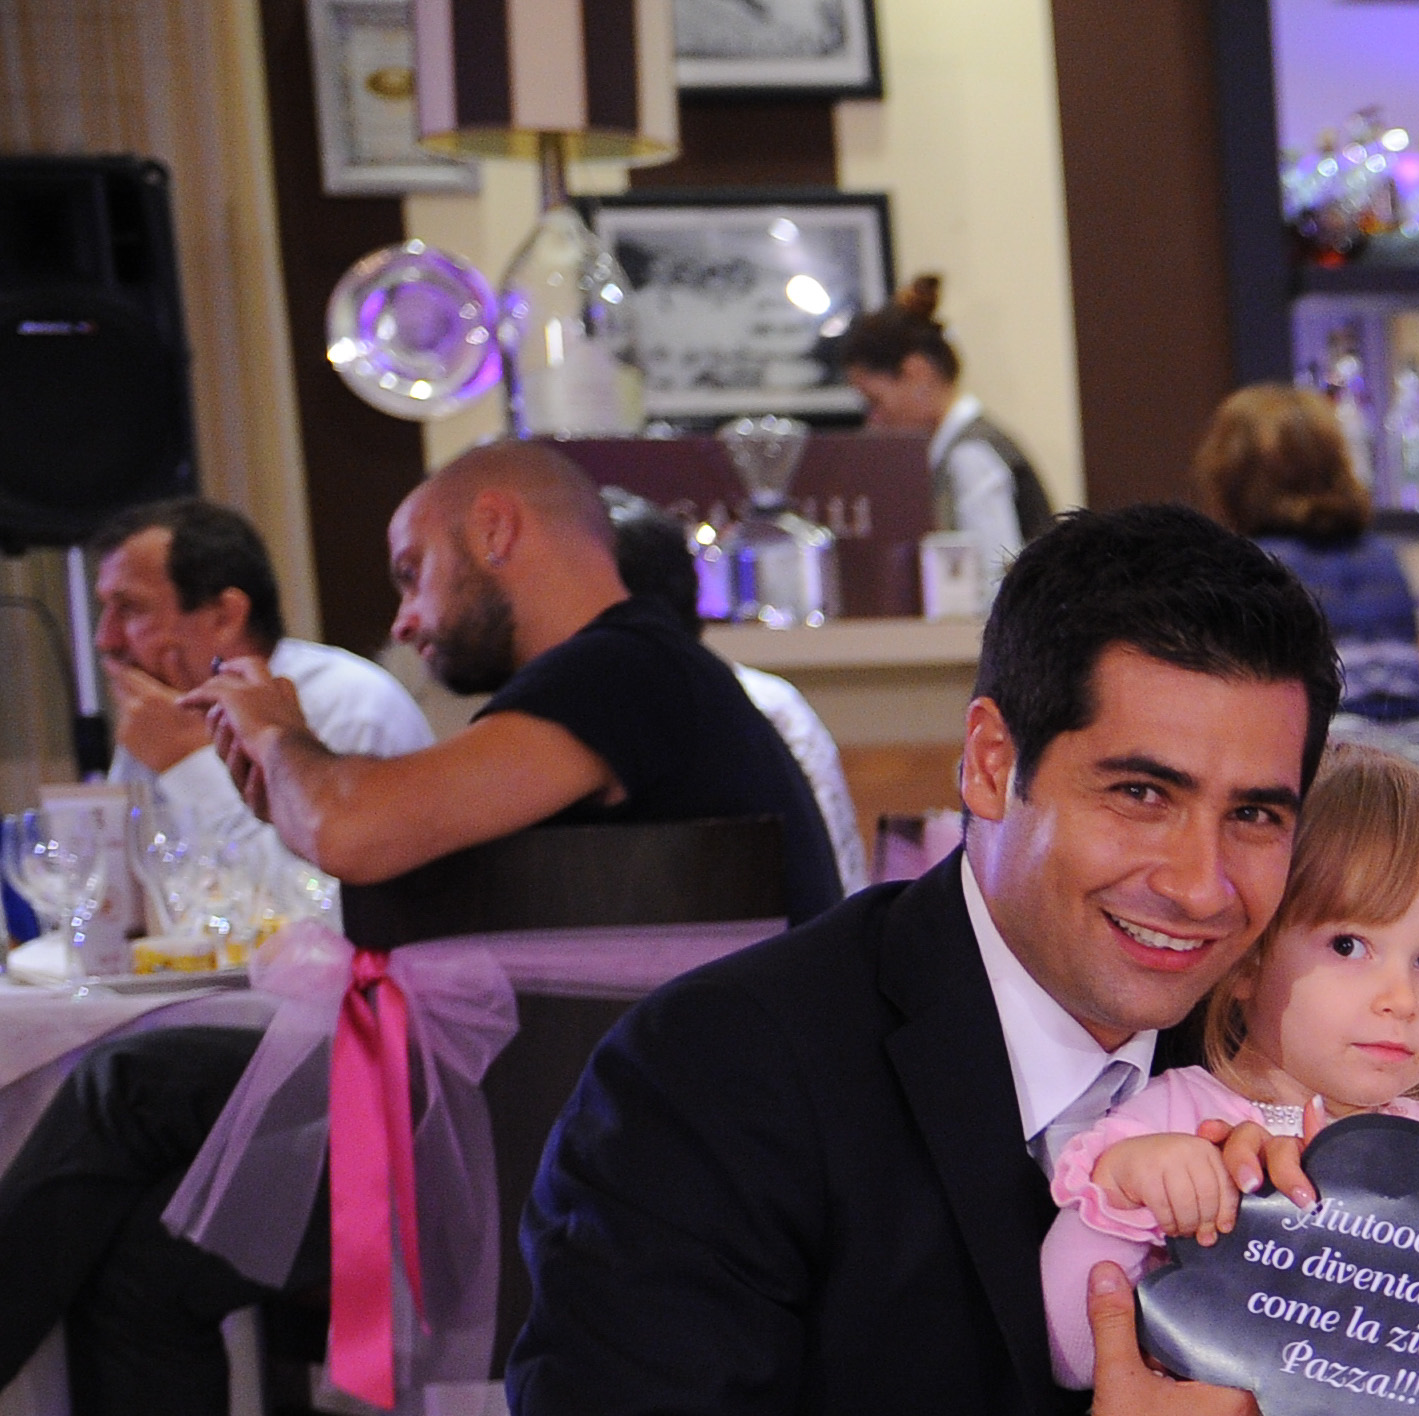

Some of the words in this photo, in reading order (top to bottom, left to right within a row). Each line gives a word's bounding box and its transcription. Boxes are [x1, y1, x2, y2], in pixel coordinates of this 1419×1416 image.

[1244, 1237, 1294, 1269] sto
[1247, 1292, 1340, 1332] come
[1346, 1306, 1380, 1343] la
